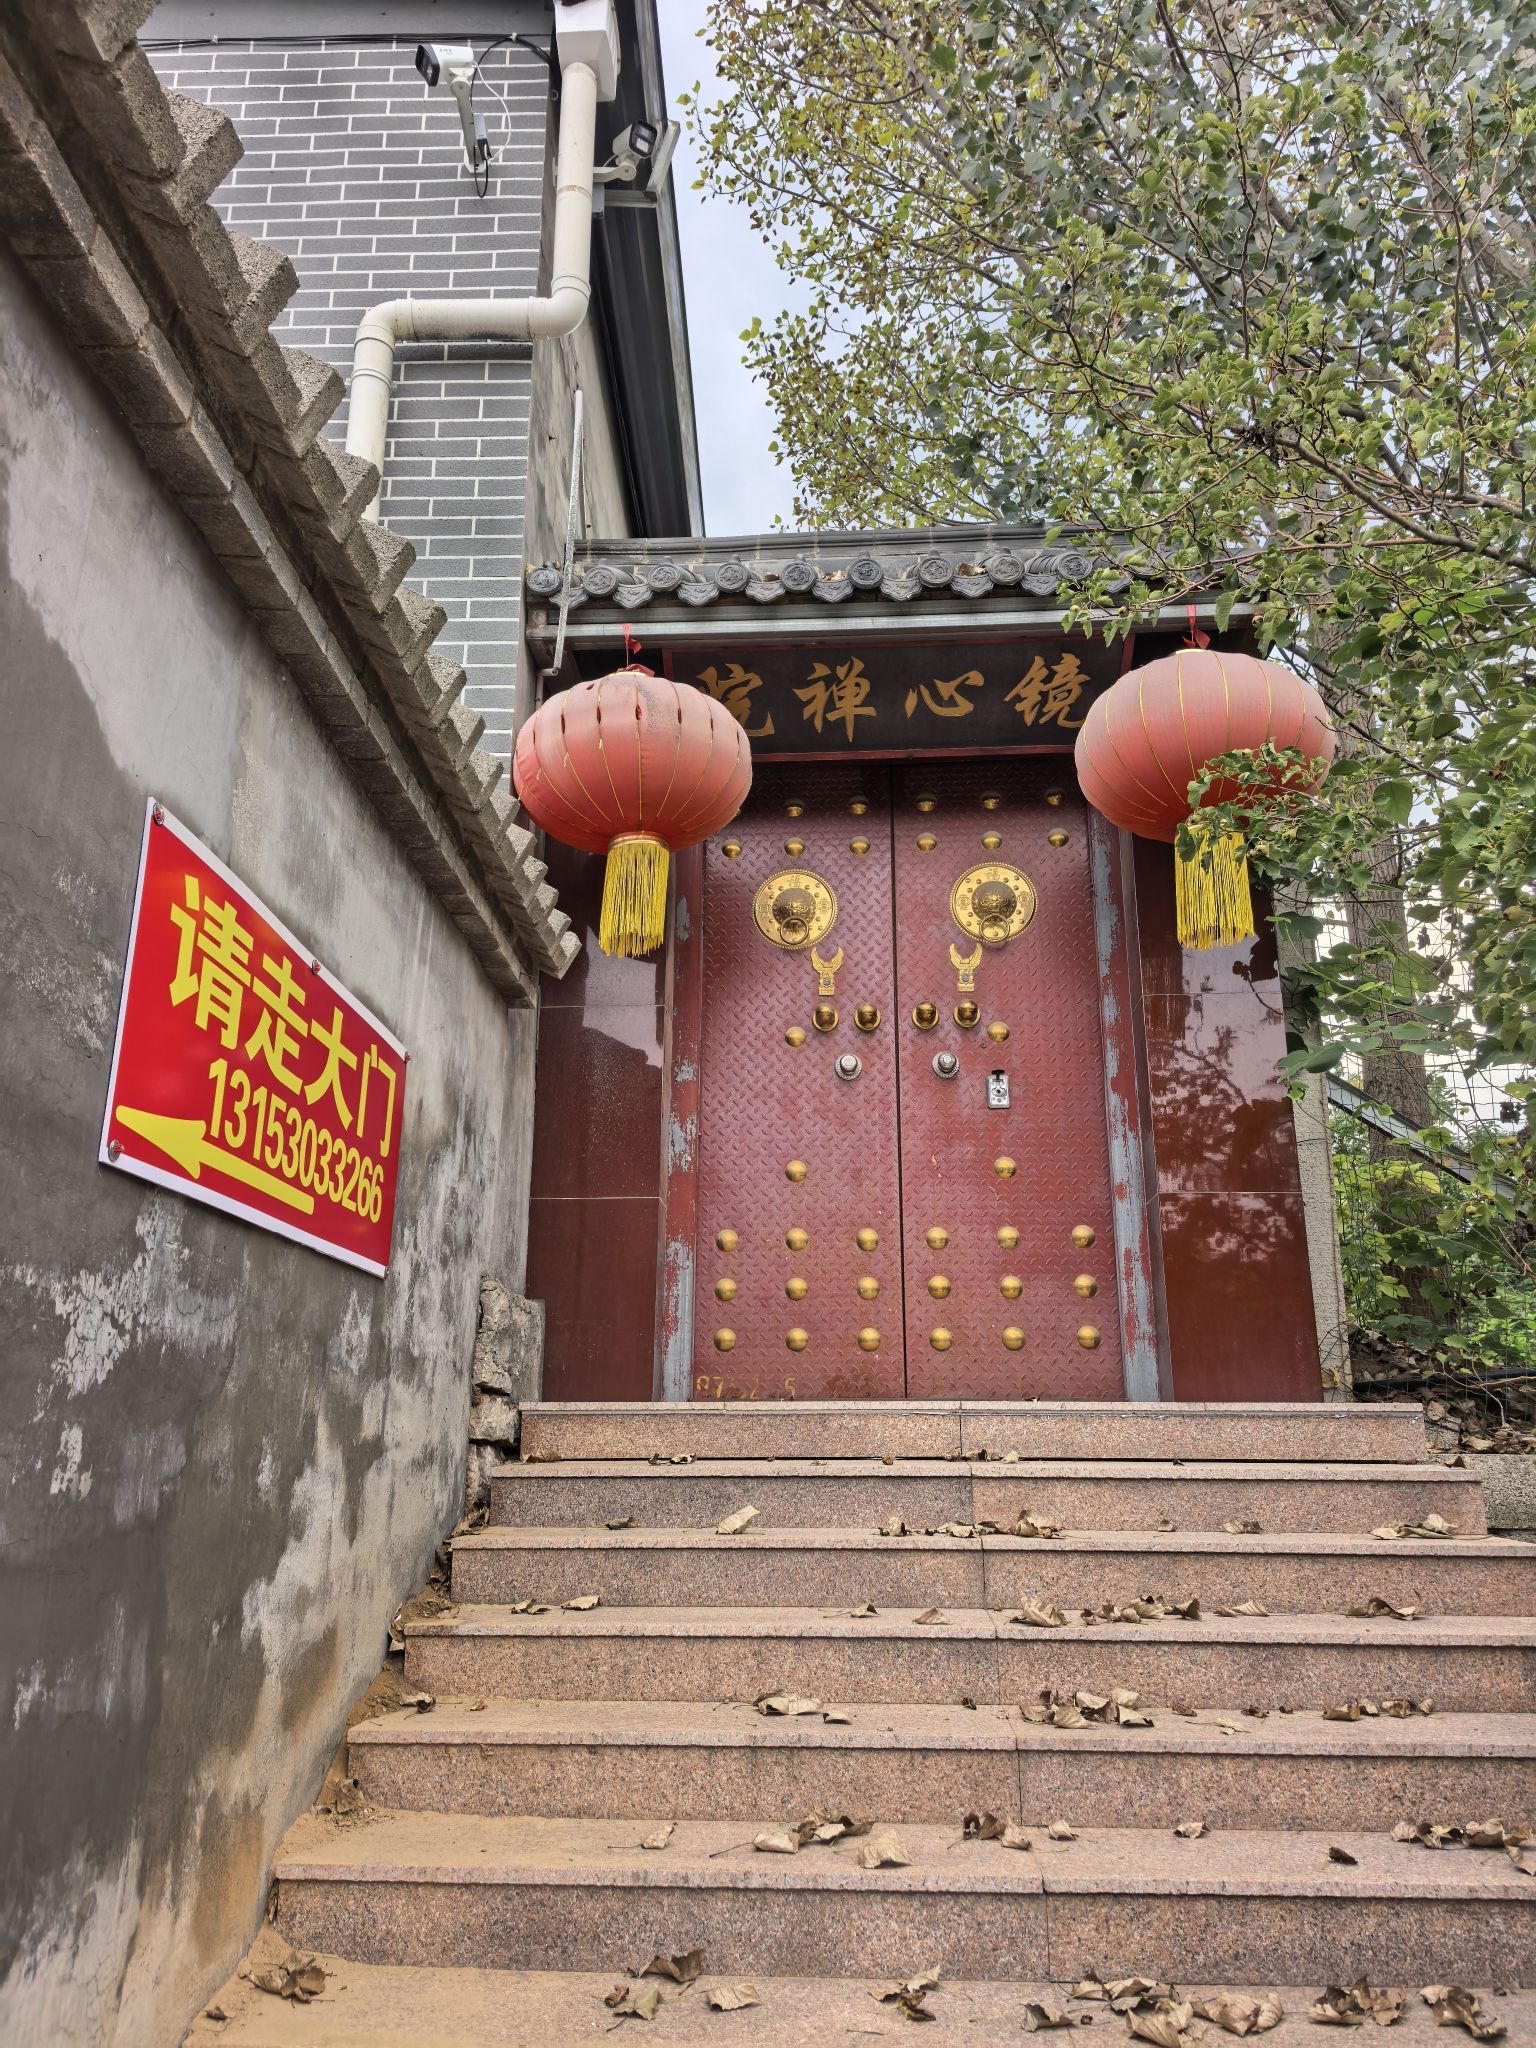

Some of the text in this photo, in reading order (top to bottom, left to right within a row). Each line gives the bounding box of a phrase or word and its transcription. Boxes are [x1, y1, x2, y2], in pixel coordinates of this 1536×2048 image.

[169, 874, 397, 1157] 请走大门
[207, 1058, 384, 1223] 13153033266
